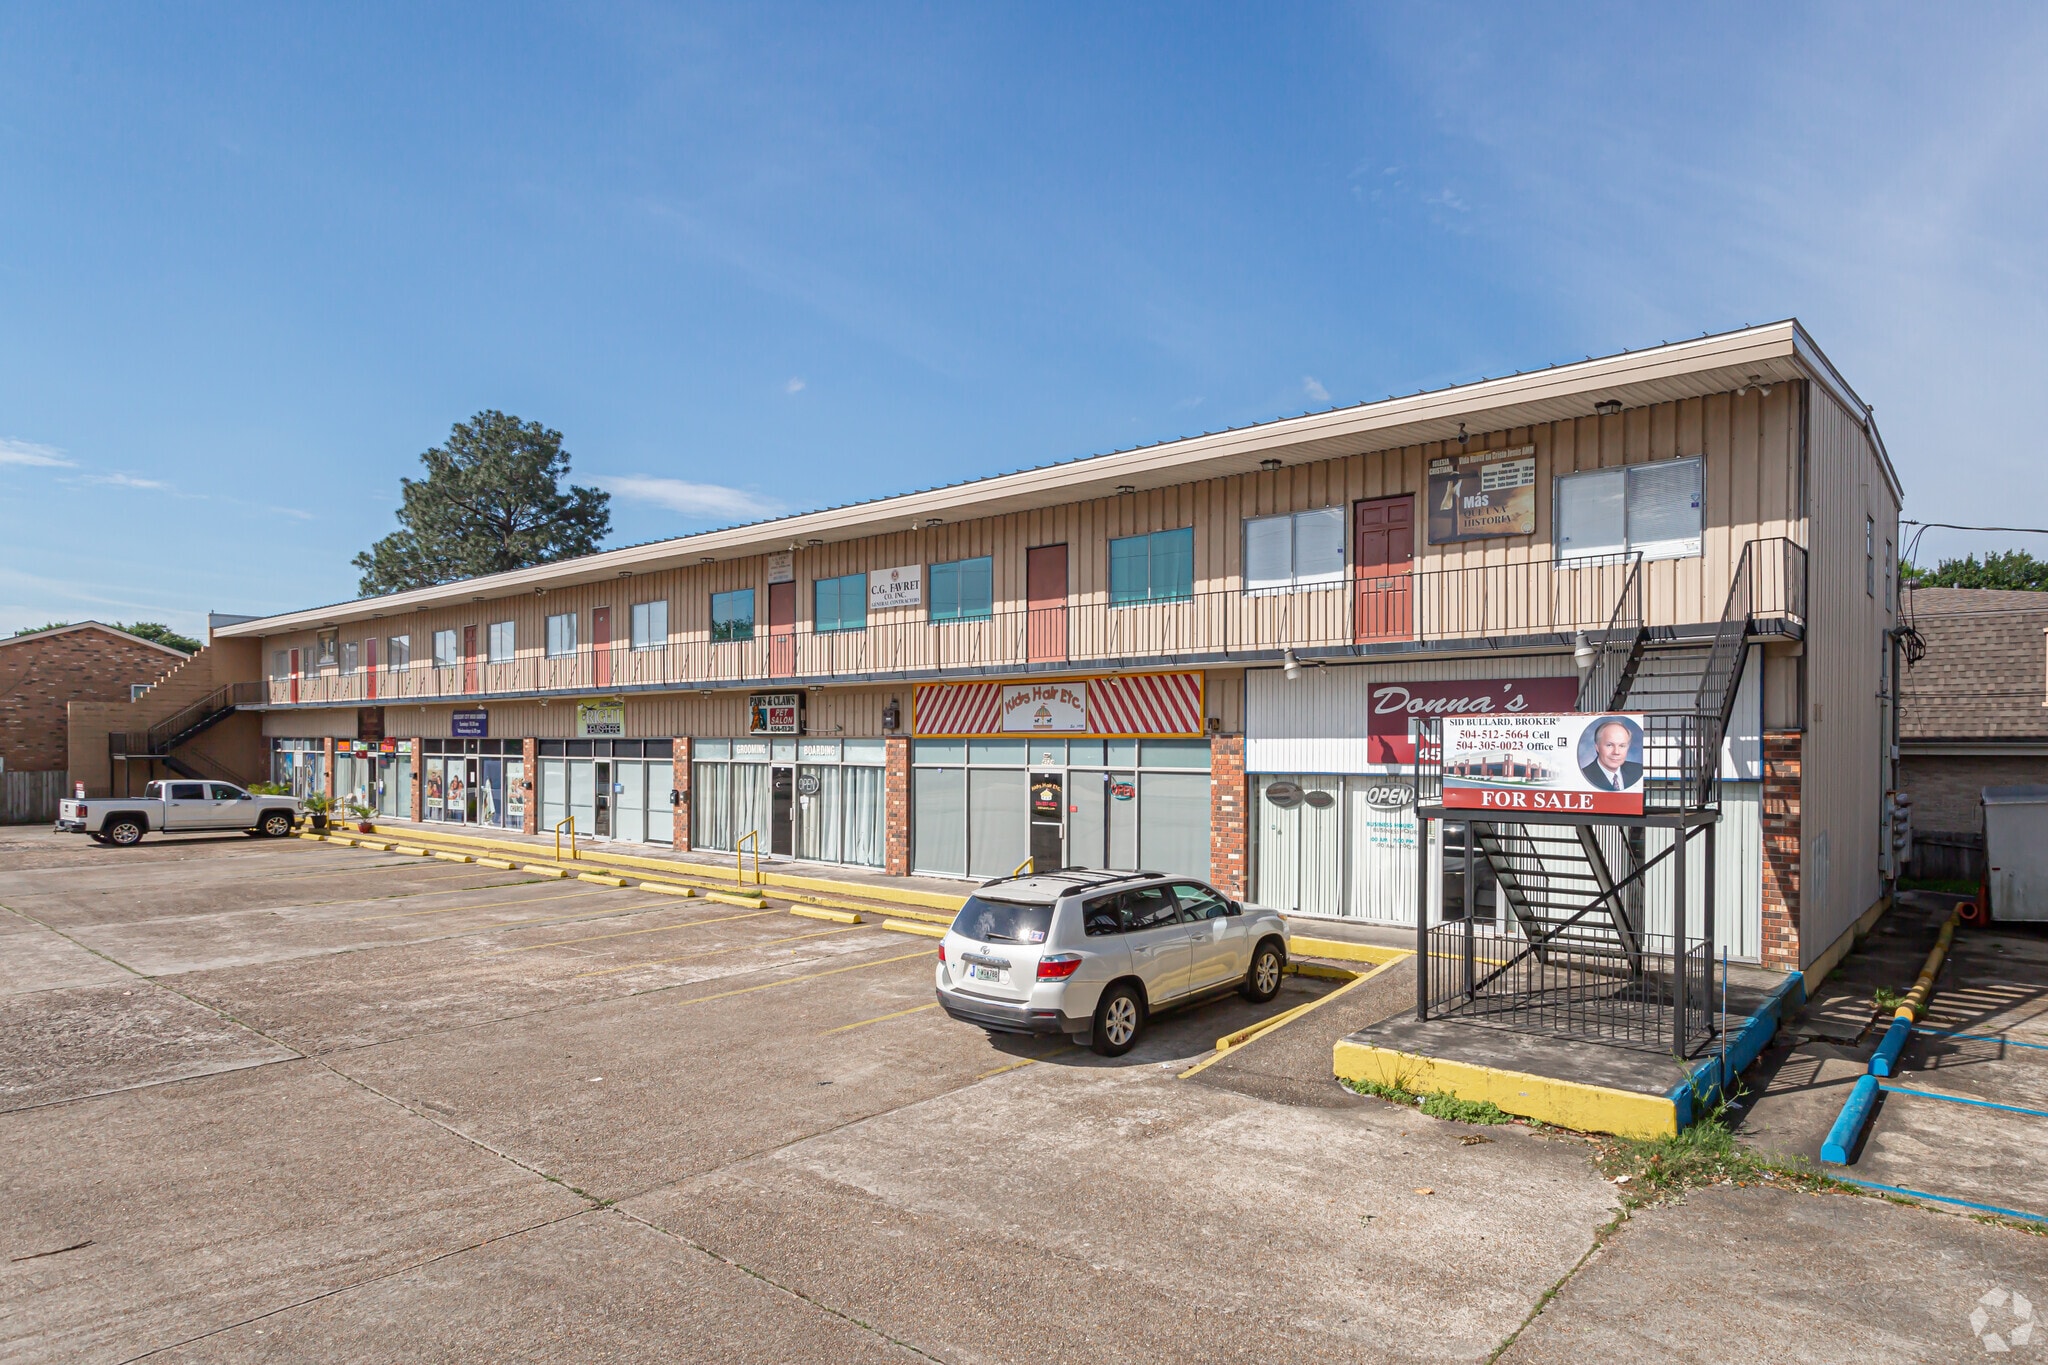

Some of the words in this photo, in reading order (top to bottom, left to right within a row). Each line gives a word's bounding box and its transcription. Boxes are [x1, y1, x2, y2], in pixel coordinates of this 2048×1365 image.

[1432, 458, 1449, 467] IGLESIA
[1429, 466, 1453, 475] CRISTIANA
[1464, 492, 1489, 508] Más
[1464, 508, 1481, 518] QUE
[1486, 506, 1506, 514] UNA
[1464, 515, 1511, 527] HISTORIA
[872, 585, 887, 594] C.G.
[890, 580, 920, 592] FAVRET
[750, 696, 766, 706] PAWS
[768, 696, 772, 705] &
[774, 696, 795, 705] CLAWS
[1005, 692, 1030, 714] Kids
[1033, 686, 1058, 701] Hair
[1373, 684, 1528, 714] Donna's
[586, 709, 621, 723] RIGHT
[1450, 718, 1464, 726] SID
[1459, 730, 1529, 739] 504-512-5664
[1532, 730, 1550, 739] Cell
[737, 744, 765, 754] GROOMING
[804, 745, 835, 755] BOARDING
[1456, 741, 1523, 751] 504-305-0023
[1527, 743, 1554, 751] Office
[799, 778, 816, 790] OPEN
[1111, 784, 1135, 798] OPEN
[1367, 786, 1411, 805] OPEN
[1481, 791, 1527, 807] FOR
[1534, 792, 1594, 810] SALE
